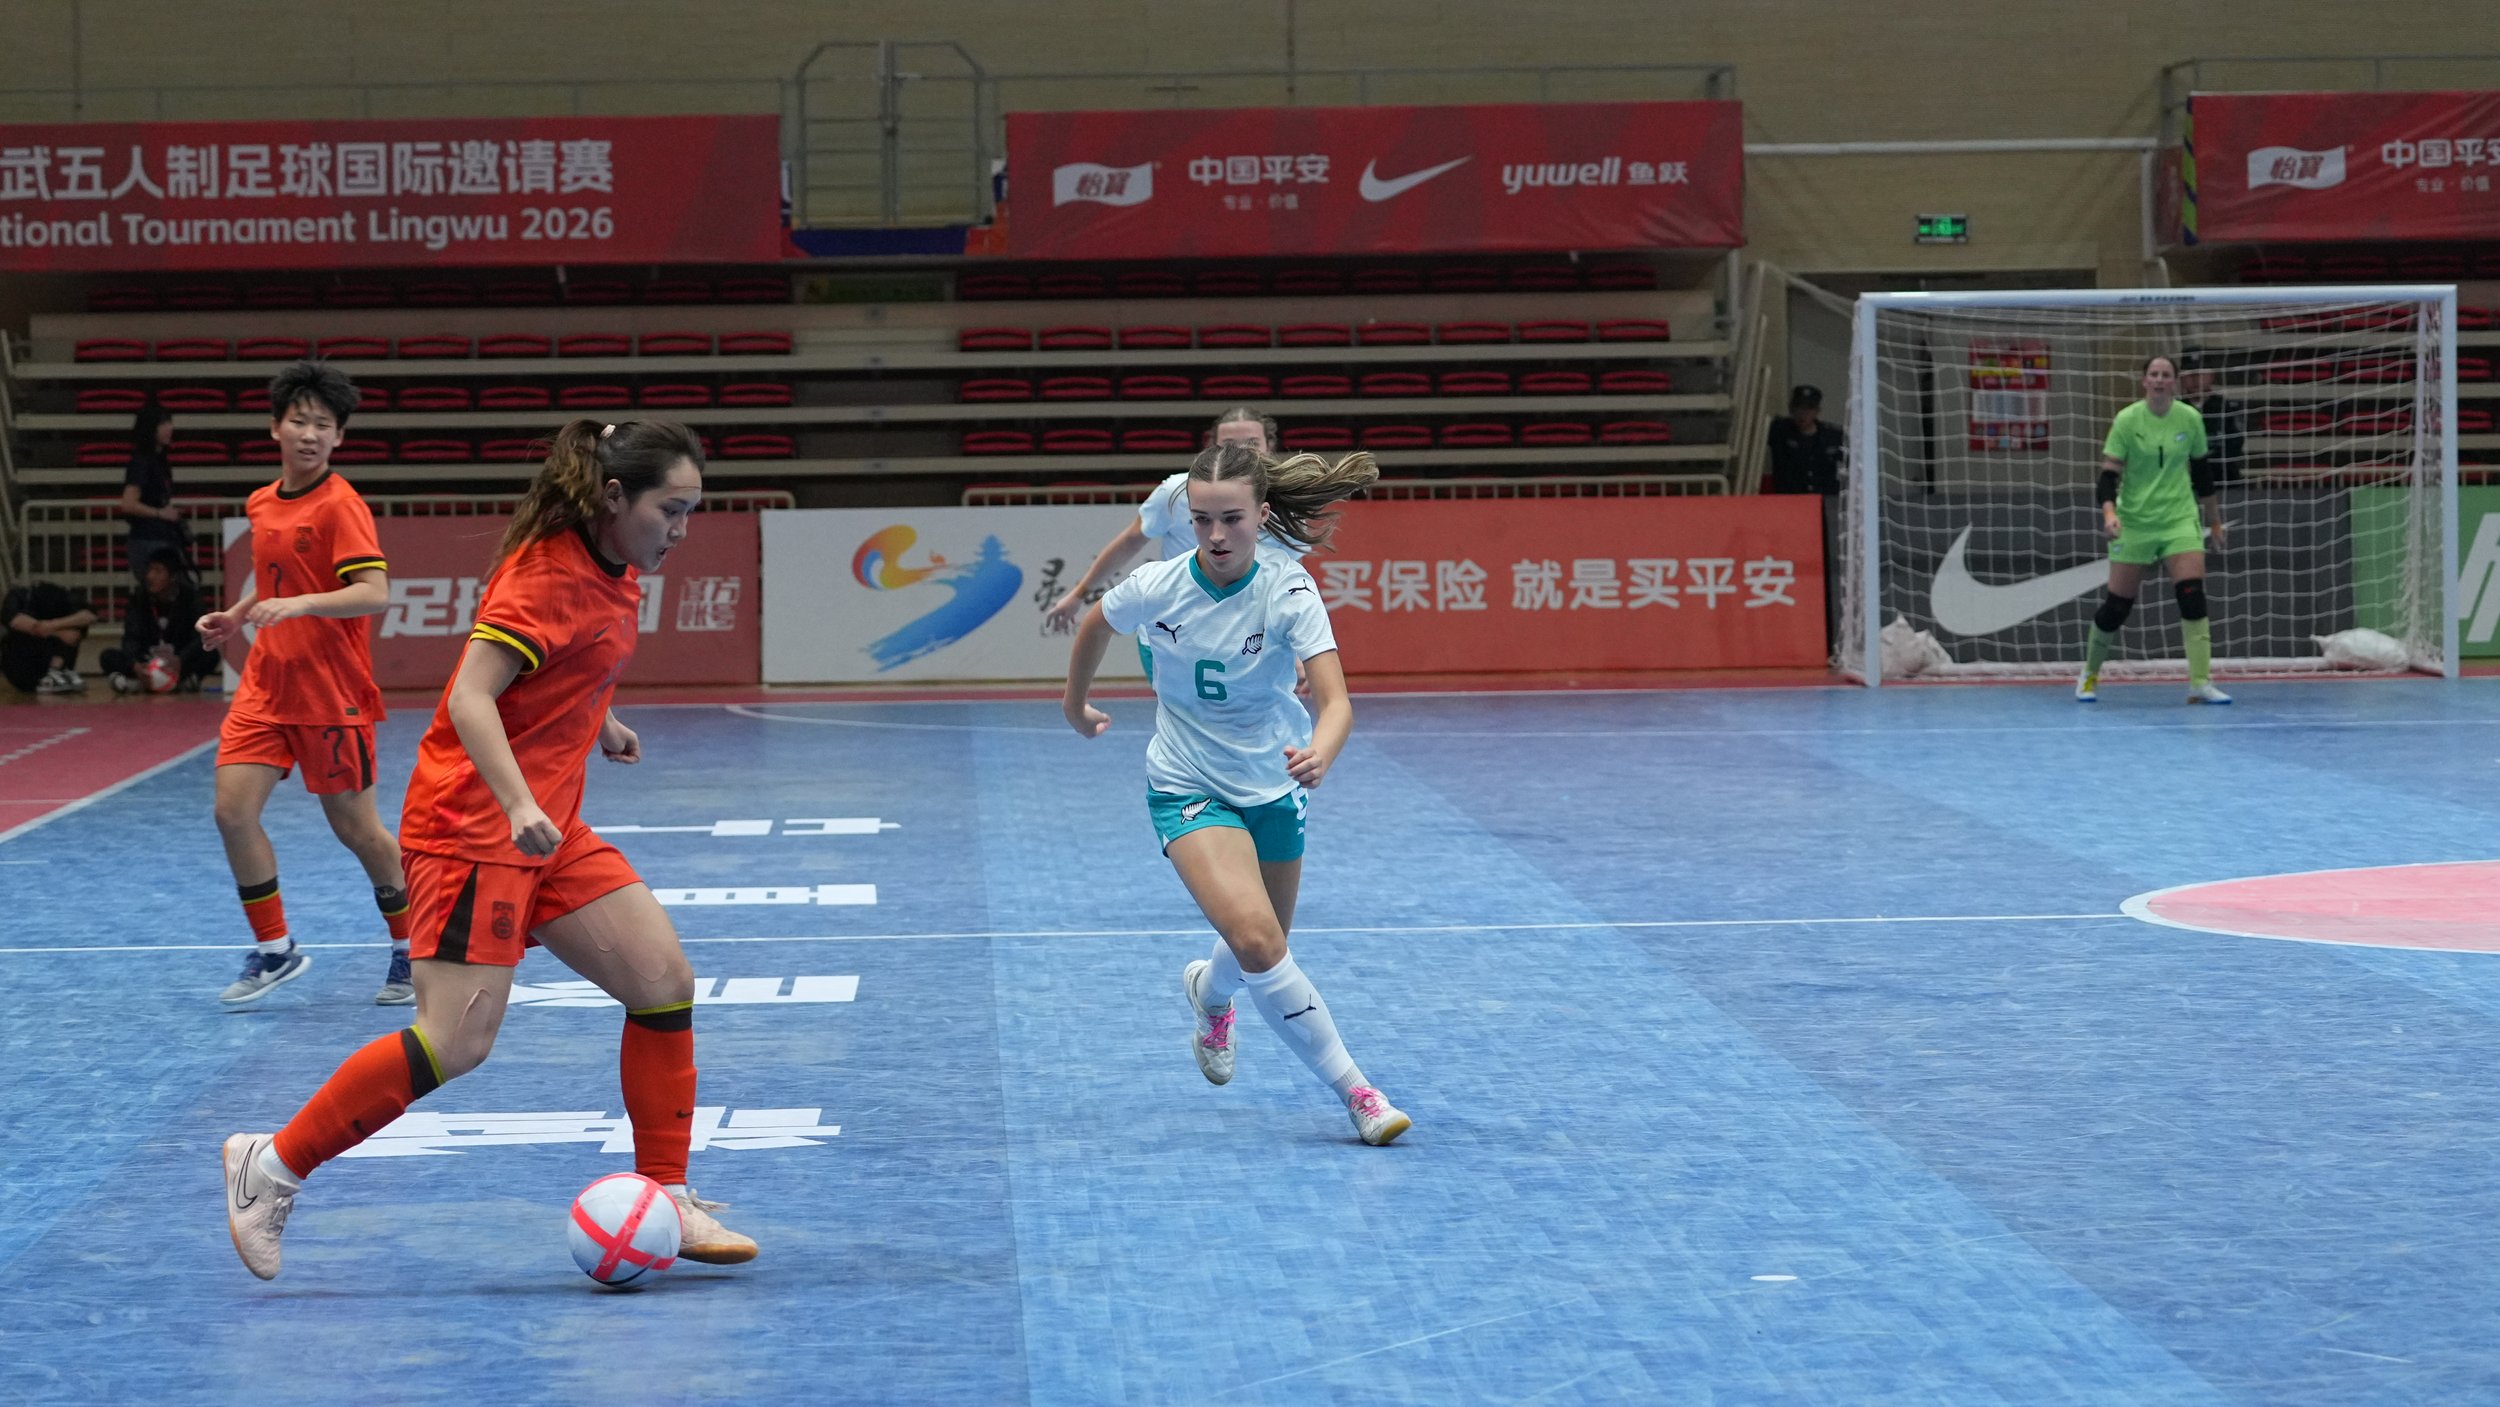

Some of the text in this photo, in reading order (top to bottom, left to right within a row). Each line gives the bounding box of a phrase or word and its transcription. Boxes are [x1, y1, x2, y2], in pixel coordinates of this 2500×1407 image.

[0, 139, 613, 201] 武五人制足球国际邀请赛
[1188, 154, 1330, 186] 中国平安
[1502, 156, 1689, 195] yuwell 鱼跃
[121, 211, 356, 245] Tournament
[368, 207, 508, 250] Lingwu
[521, 206, 614, 240] 2026
[1320, 555, 1797, 612] 买保险 就是买平安
[1195, 659, 1227, 701] 6
